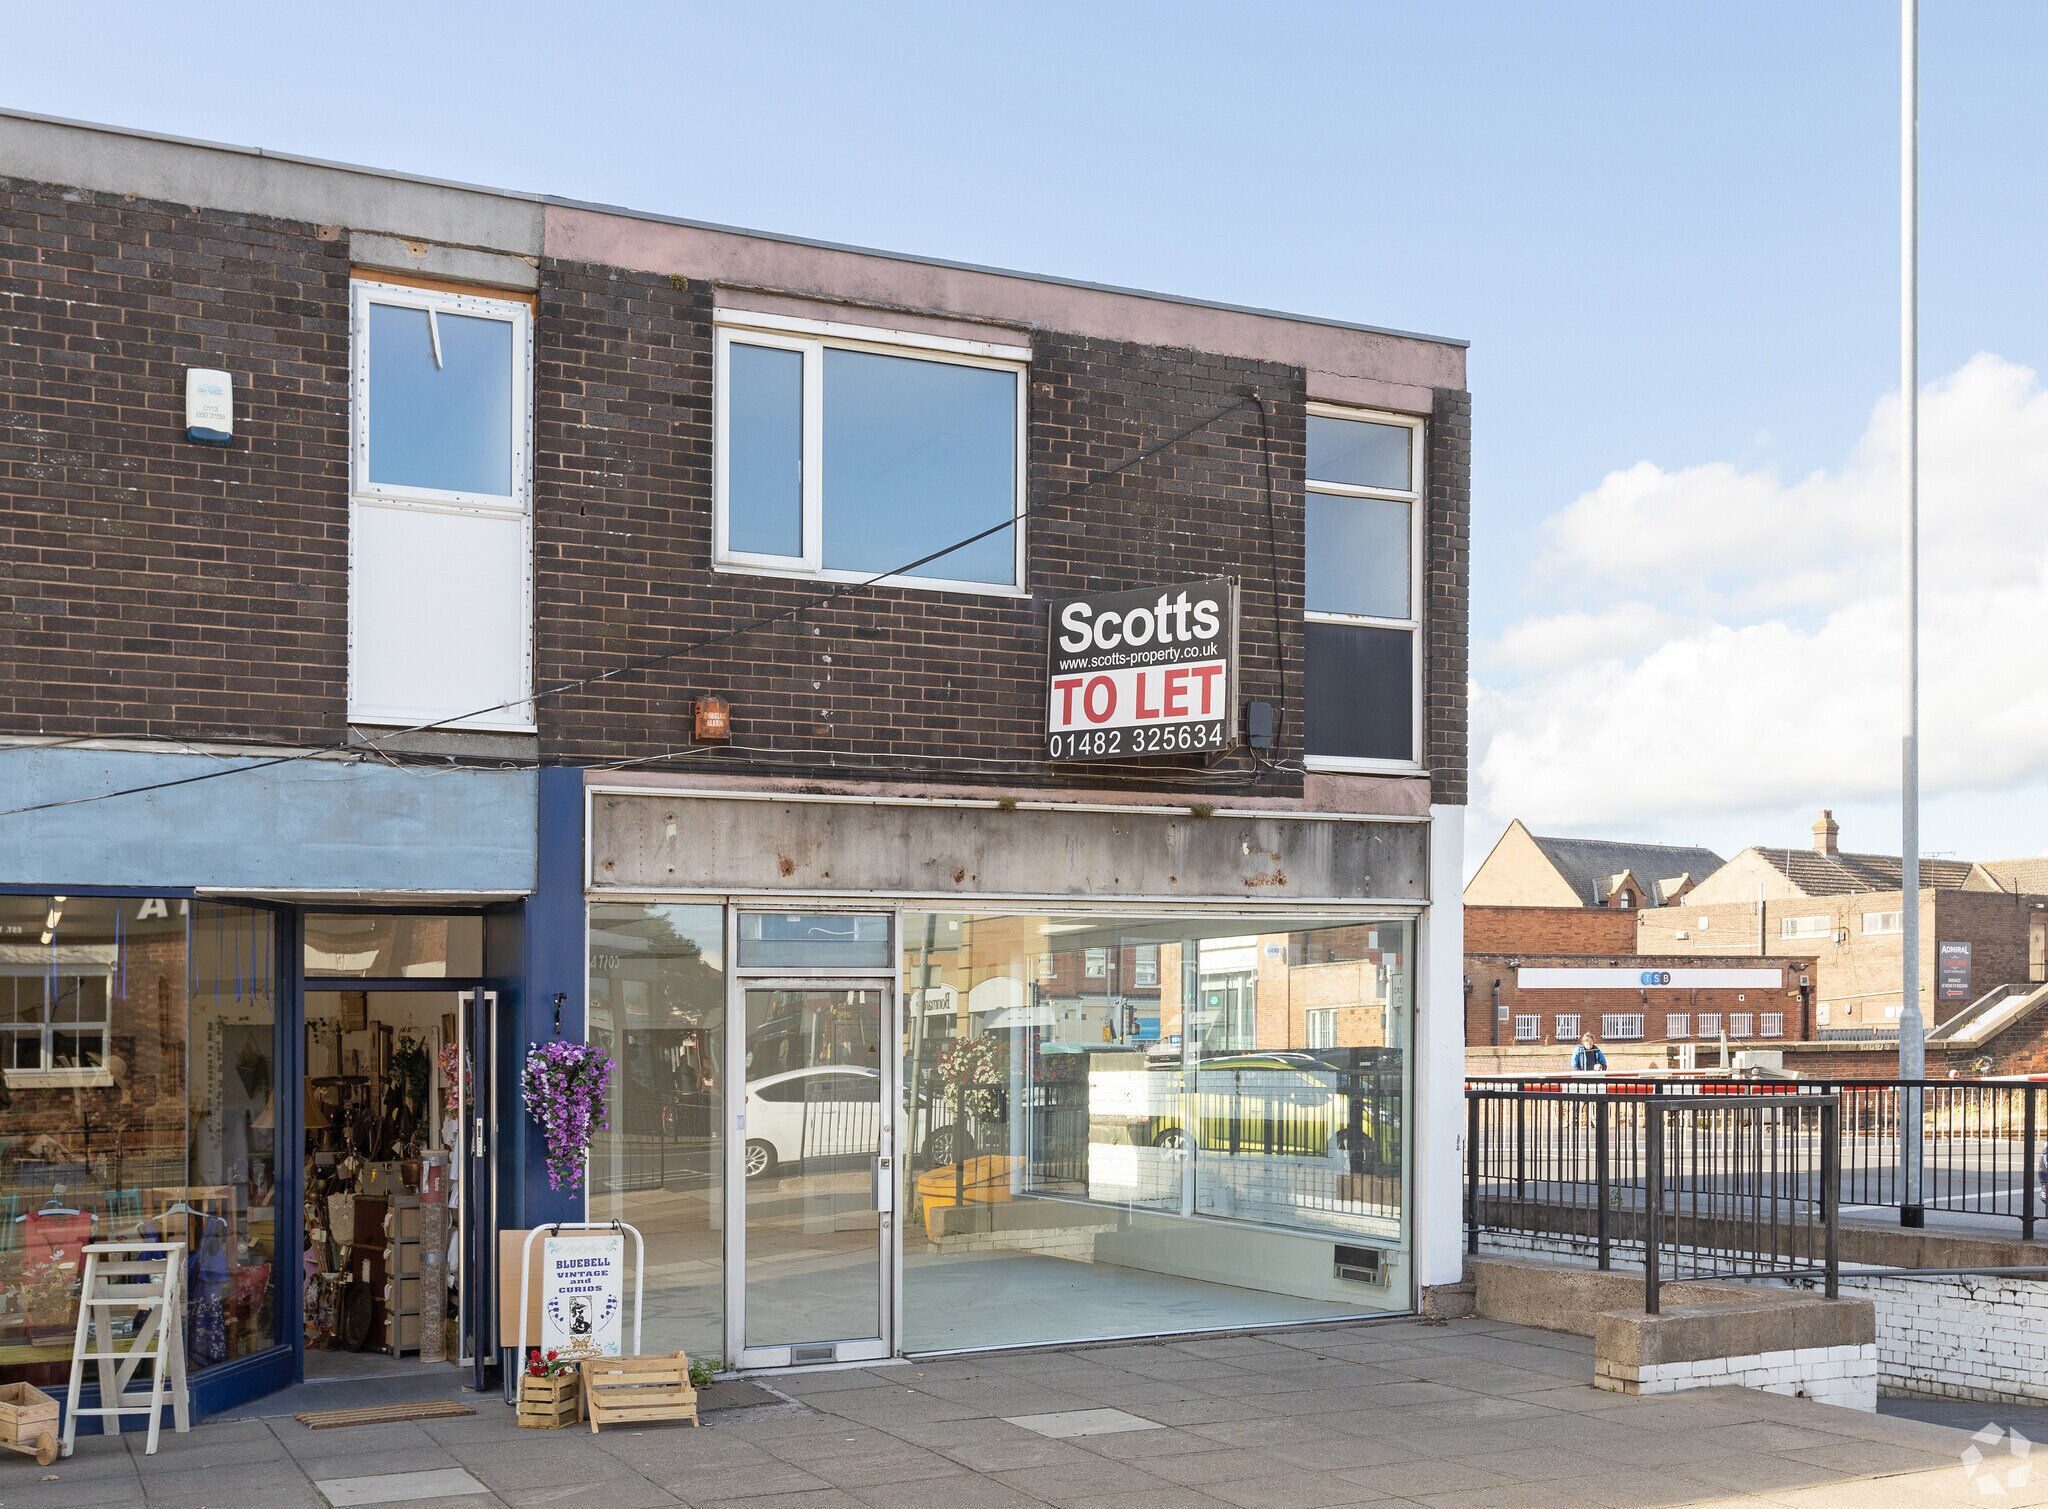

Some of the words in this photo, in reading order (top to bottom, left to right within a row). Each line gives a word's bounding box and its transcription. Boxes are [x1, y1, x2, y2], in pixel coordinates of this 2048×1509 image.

[1059, 591, 1220, 653] Scotts
[1059, 642, 1218, 670] www.scotts-property.co.uk
[1054, 675, 1117, 725] TO
[1135, 665, 1223, 720] LET
[1050, 730, 1121, 757] 01482
[1132, 723, 1222, 752] 325634
[1941, 945, 1969, 954] ADMIRAL
[1644, 973, 1669, 983] TSB
[556, 1257, 610, 1269] BLUEBELL
[557, 1270, 609, 1278] VINTAGE
[558, 1285, 602, 1293] CURIOS
